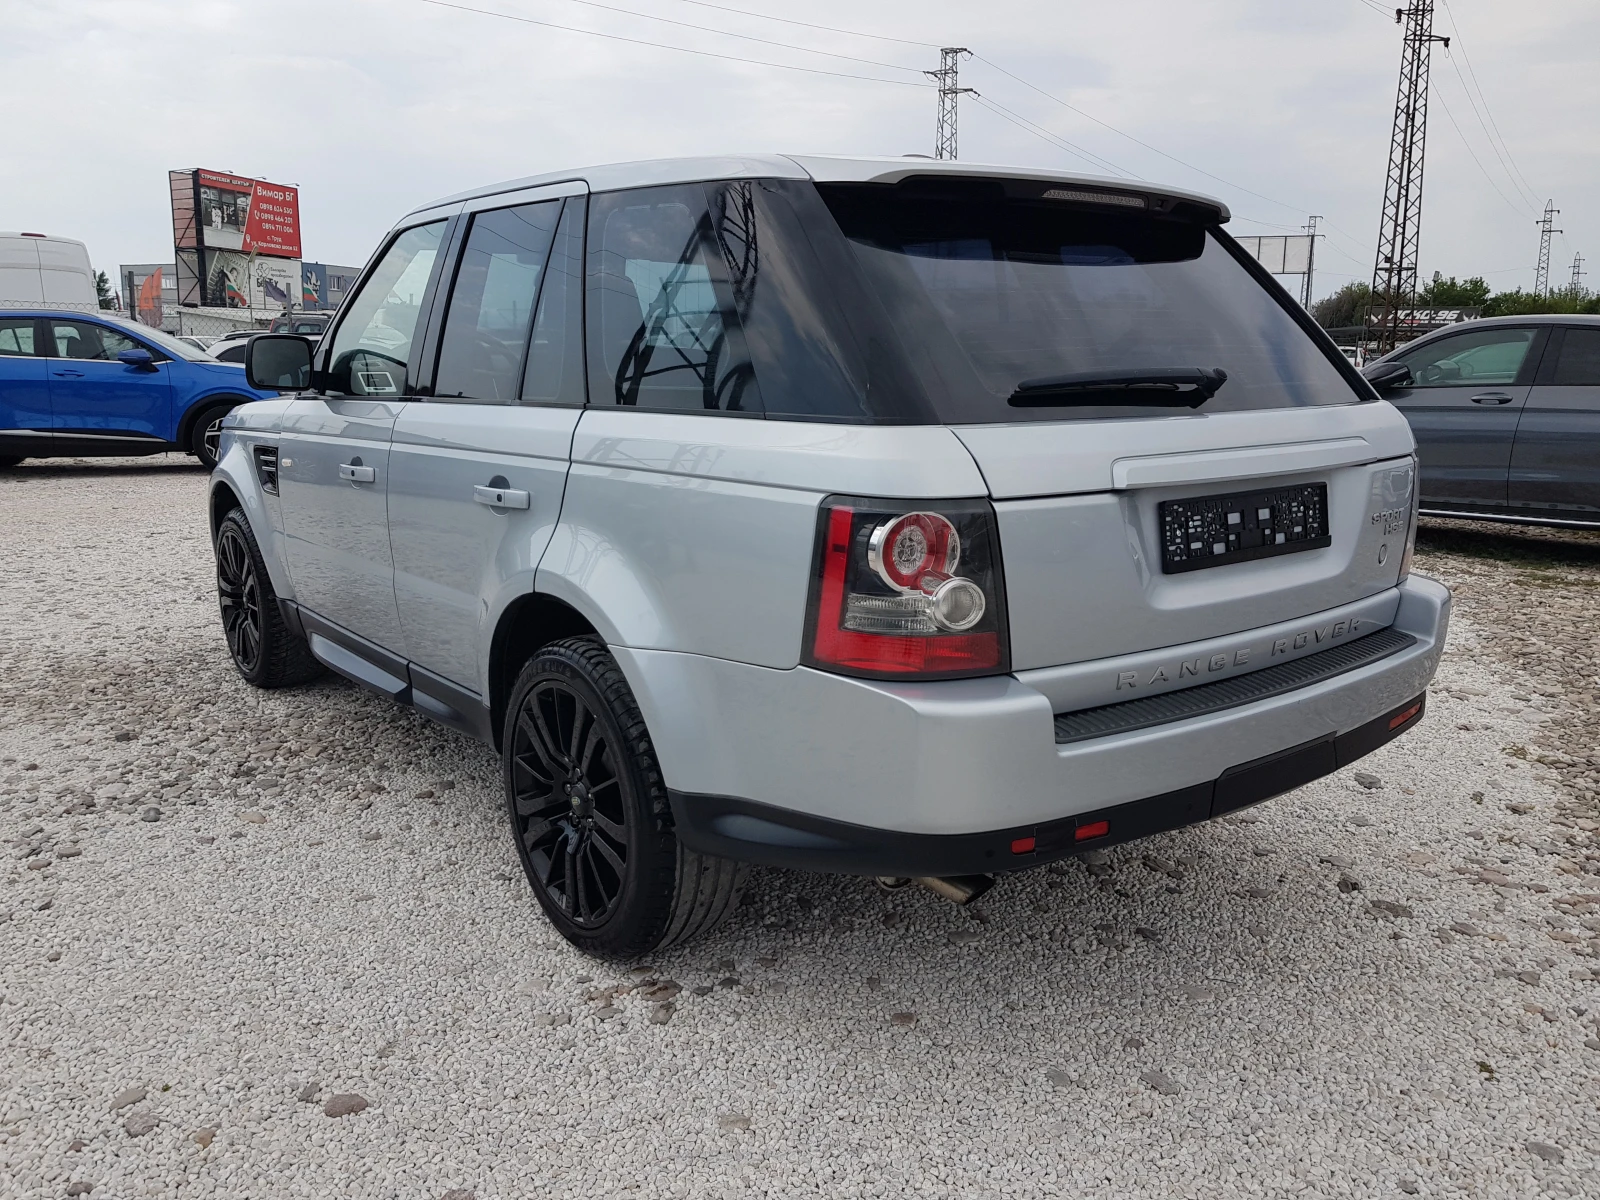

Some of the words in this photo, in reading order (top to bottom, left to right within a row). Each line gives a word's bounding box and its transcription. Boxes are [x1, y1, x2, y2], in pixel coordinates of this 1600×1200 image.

[257, 186, 284, 201] Вимар
[285, 191, 295, 201] БГ
[259, 202, 273, 211] 0898
[261, 212, 274, 221] 0898
[1371, 507, 1405, 525] SPORT
[1115, 648, 1250, 691] RANGE
[1271, 616, 1361, 657] ROVER
